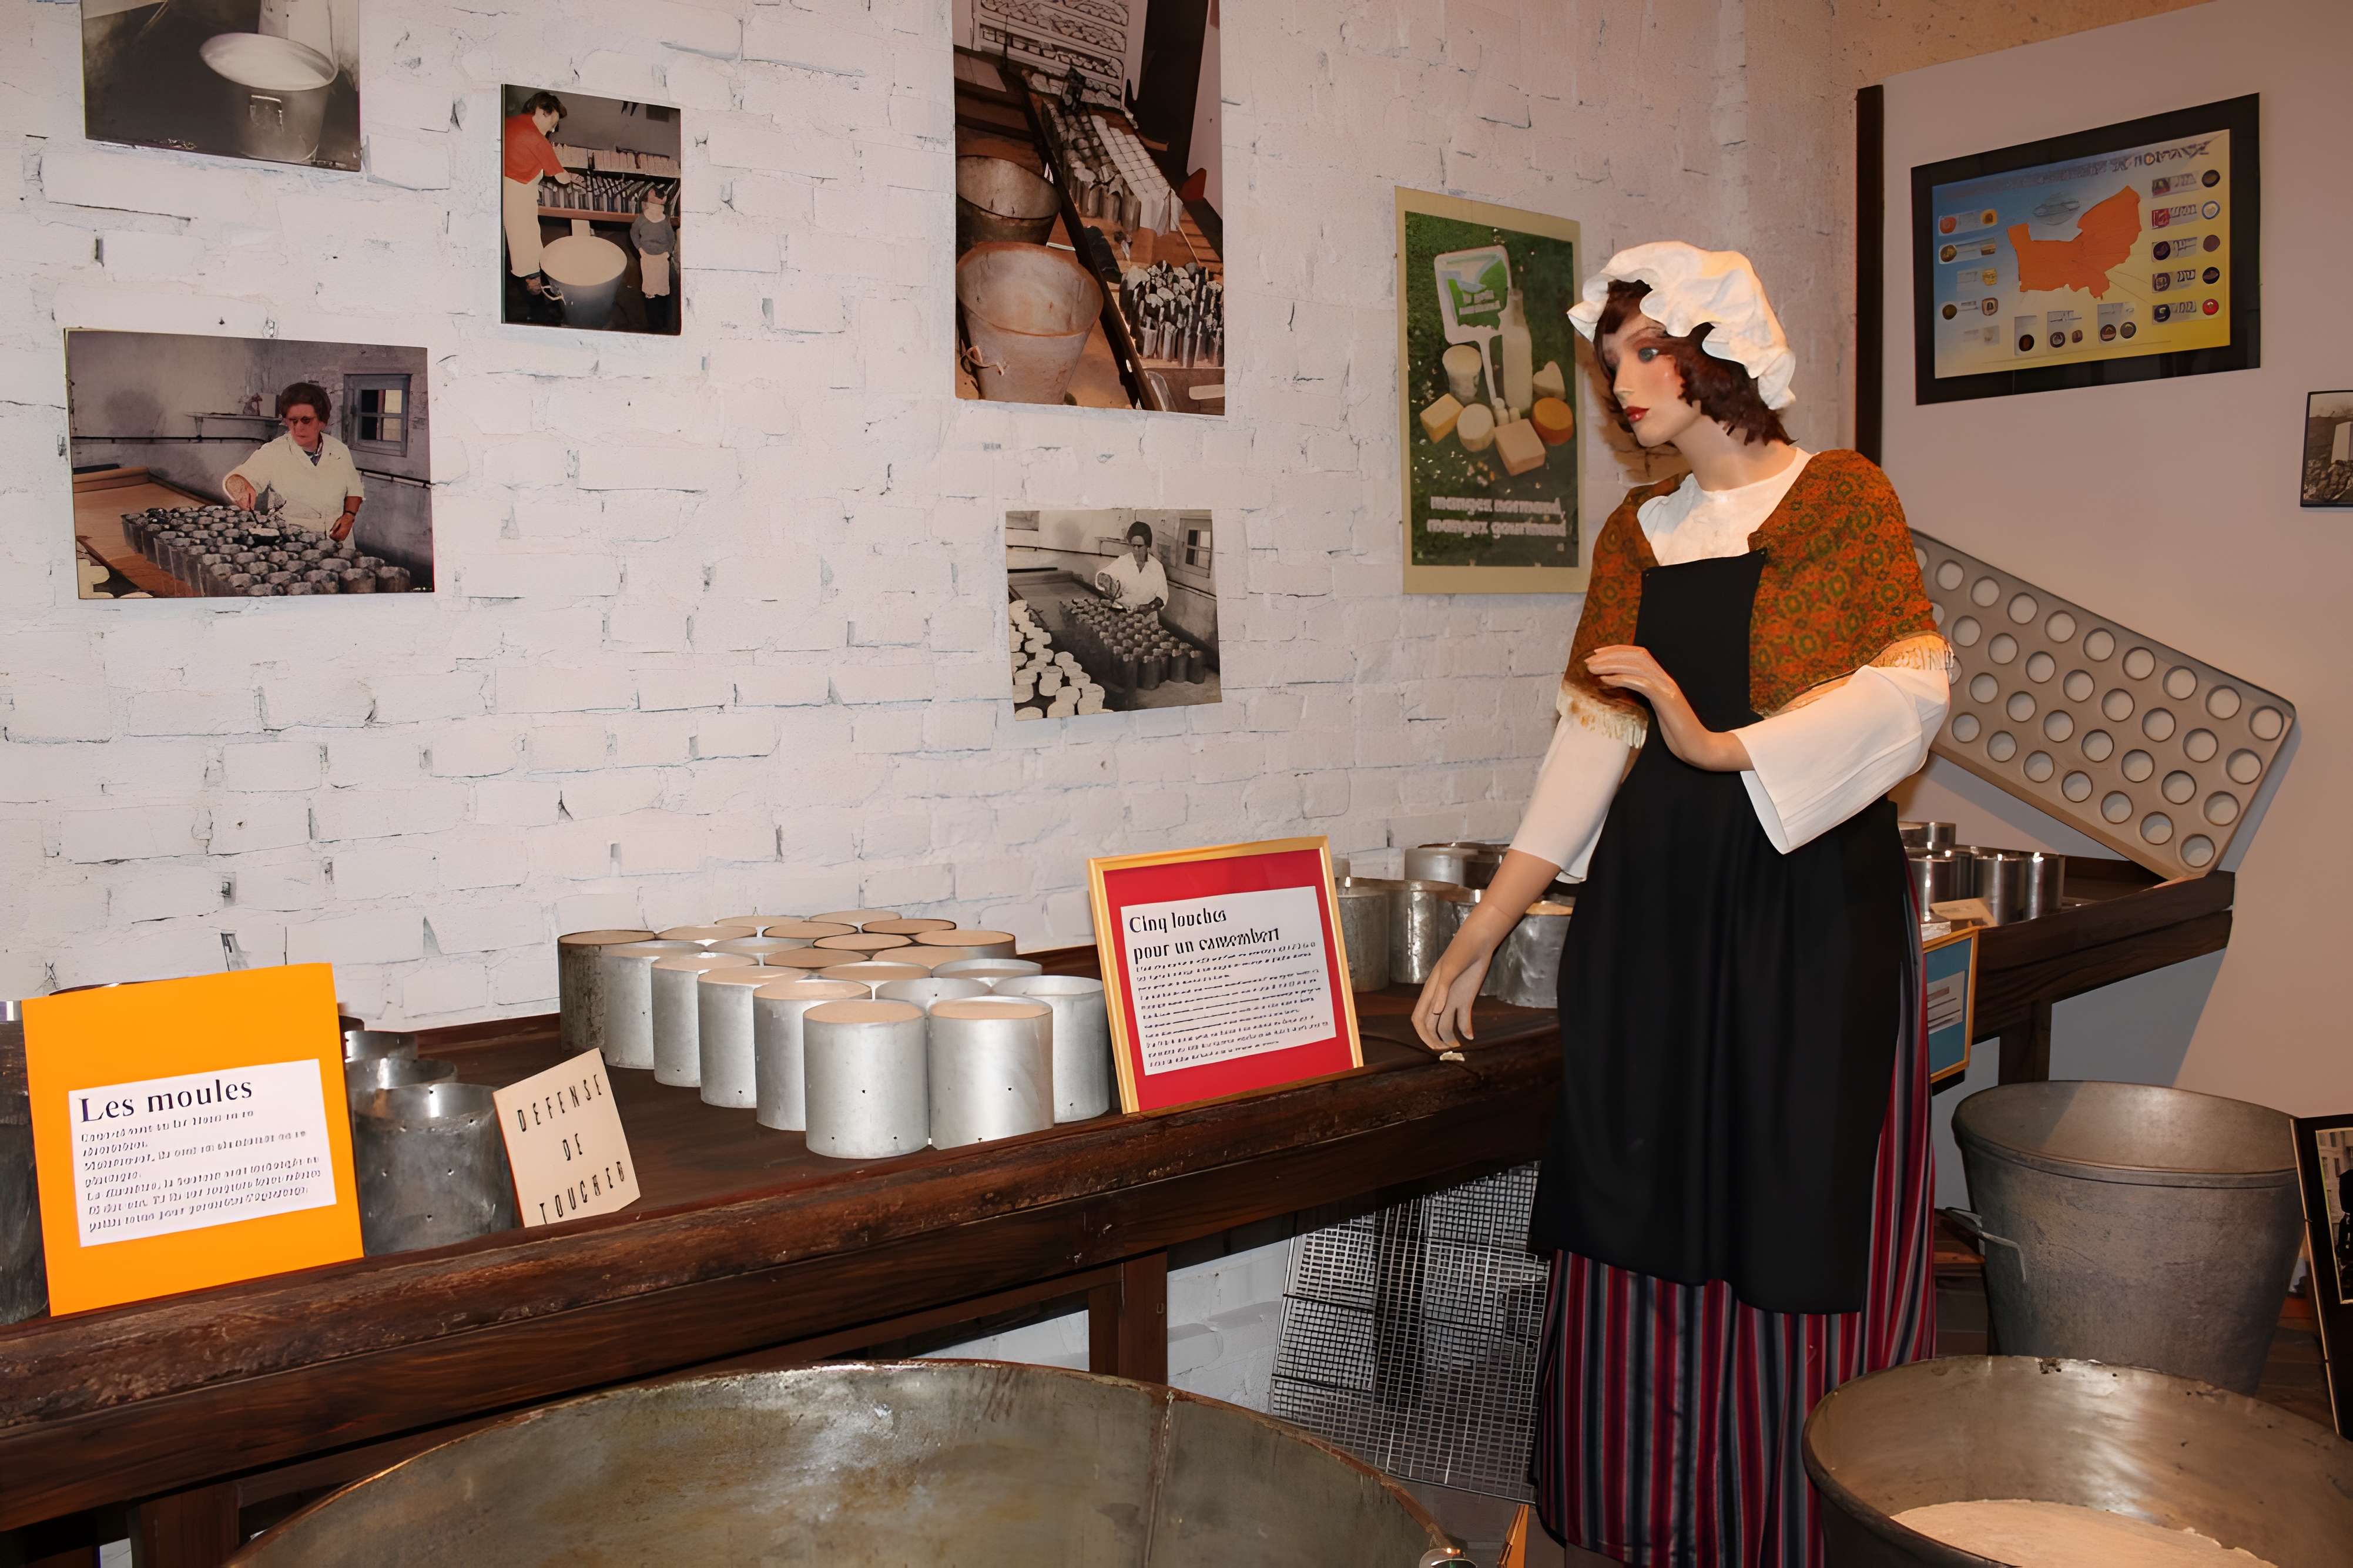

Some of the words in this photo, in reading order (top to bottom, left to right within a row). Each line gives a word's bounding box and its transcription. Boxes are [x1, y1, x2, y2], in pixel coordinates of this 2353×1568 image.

[1129, 915, 1168, 933] Cinq
[1171, 907, 1227, 929] louches
[1133, 944, 1170, 964] pour
[1175, 940, 1195, 954] un
[78, 1097, 135, 1123] Les
[148, 1079, 252, 1113] moules
[562, 1133, 584, 1161] DE
